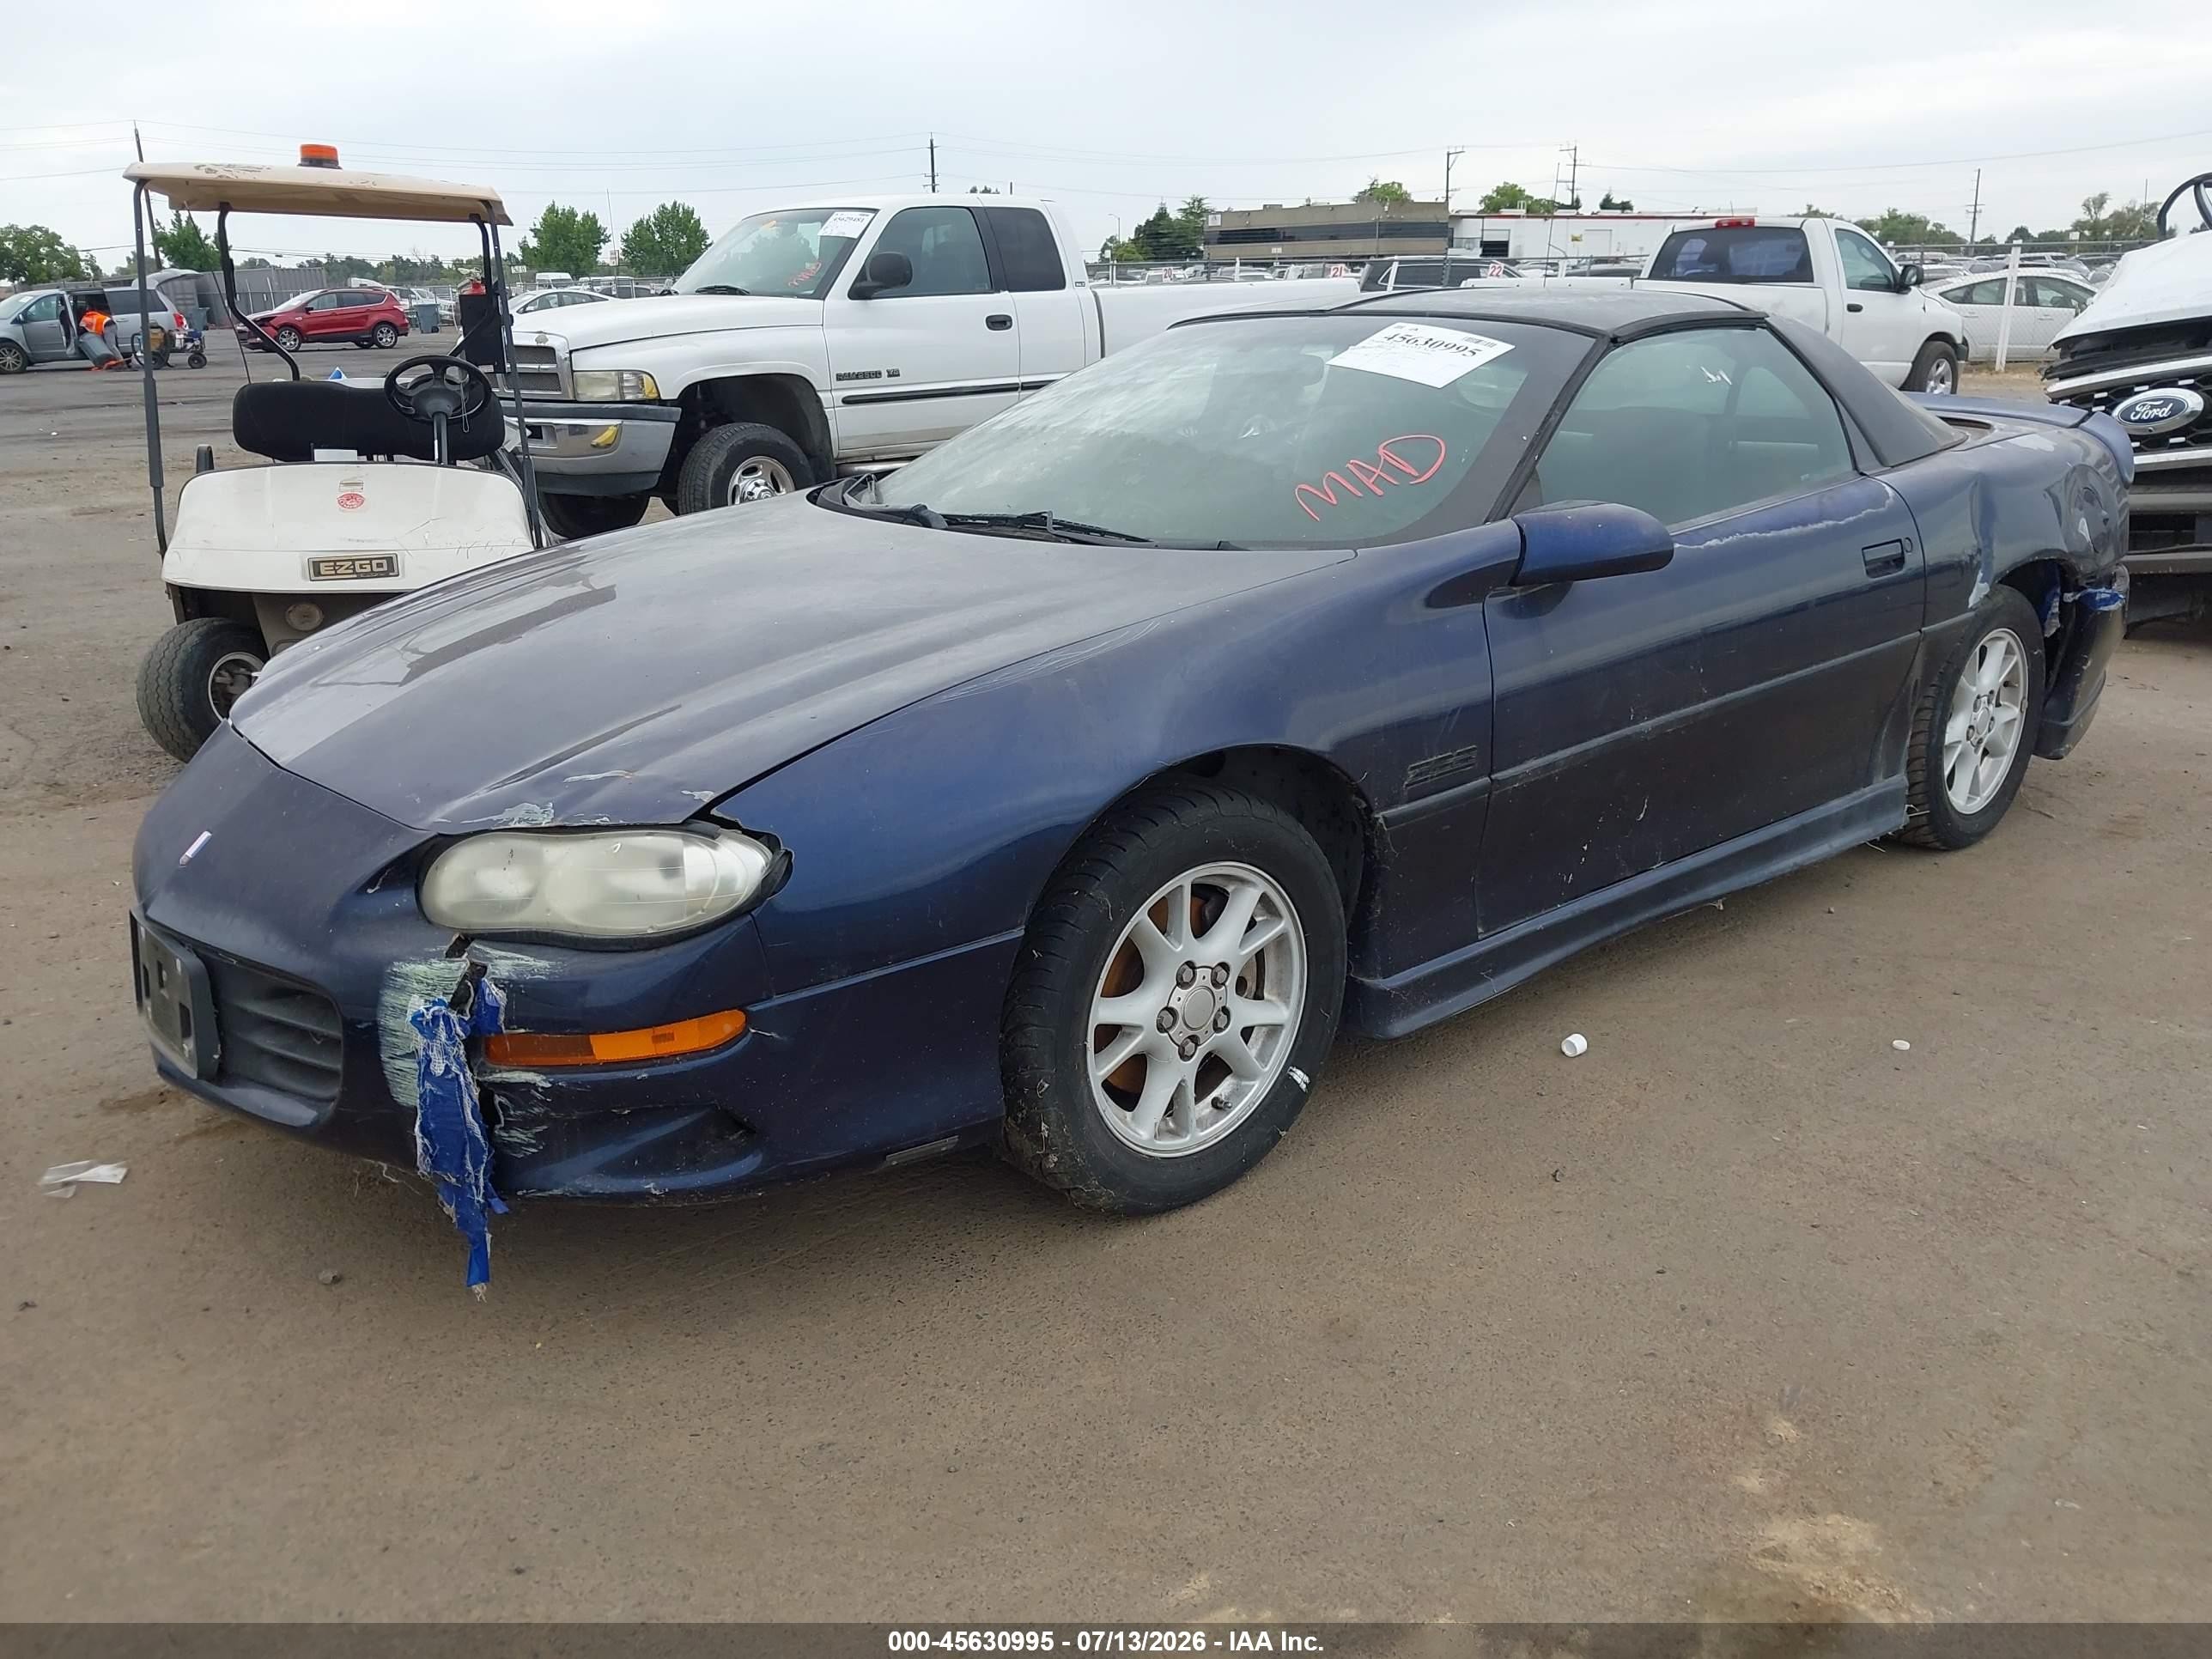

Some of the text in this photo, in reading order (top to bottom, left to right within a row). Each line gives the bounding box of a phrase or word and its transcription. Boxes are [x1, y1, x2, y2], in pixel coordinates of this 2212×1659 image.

[1332, 265, 1343, 277] 21
[1489, 265, 1502, 276] 22
[1383, 332, 1482, 357] 45630995
[2130, 399, 2173, 421] Ford
[1295, 434, 1446, 522] MAD
[319, 559, 388, 574] EZGO
